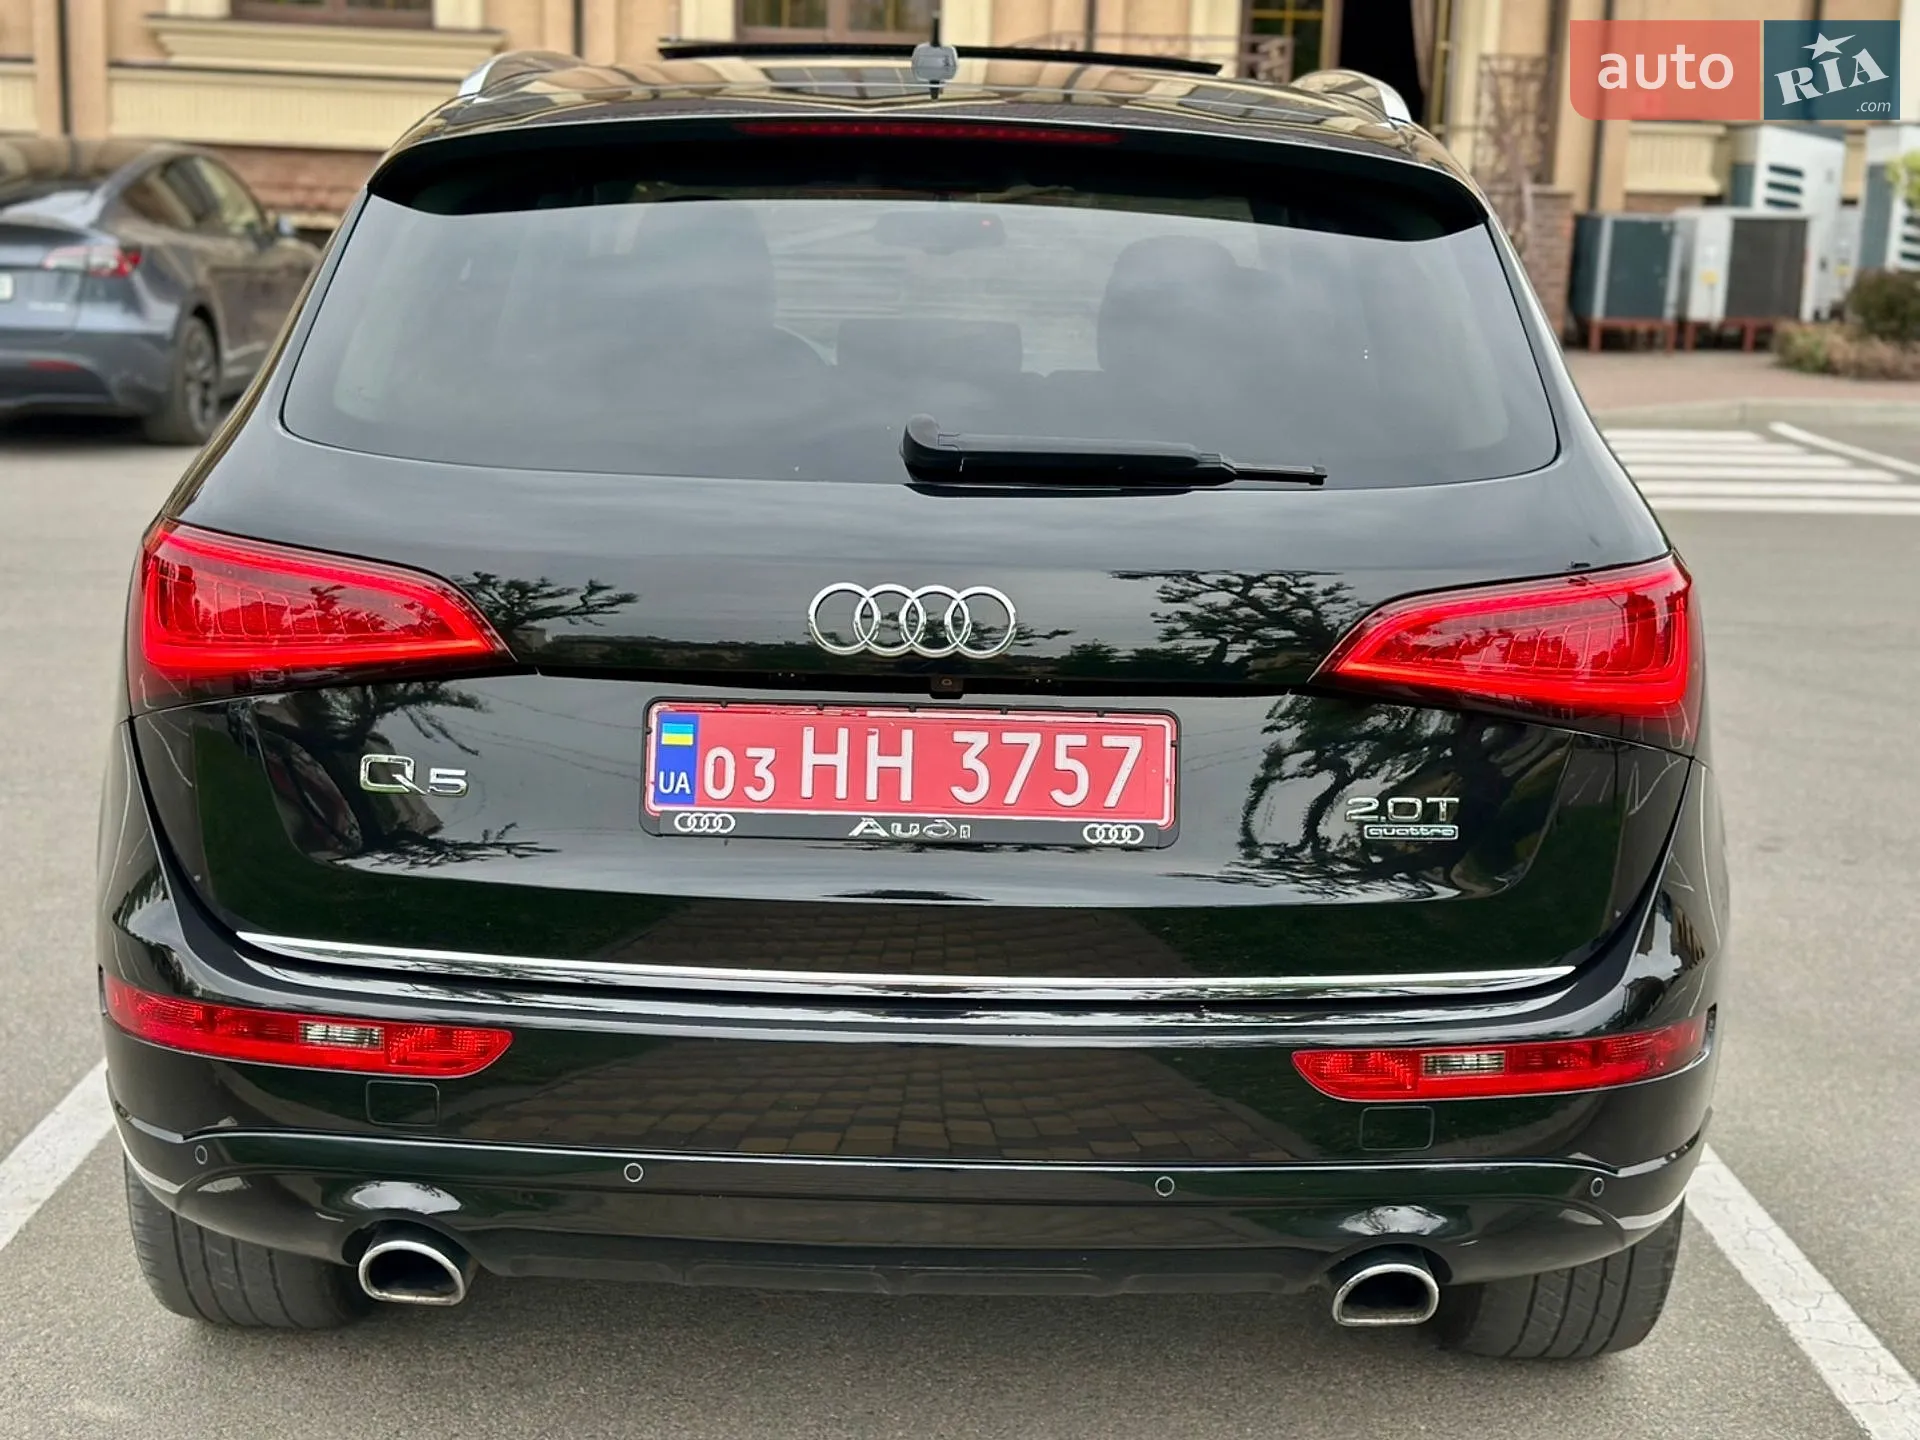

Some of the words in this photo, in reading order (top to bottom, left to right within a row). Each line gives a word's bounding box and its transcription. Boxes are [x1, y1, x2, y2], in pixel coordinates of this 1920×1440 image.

[359, 754, 469, 797] Q5
[703, 746, 776, 803] 03
[801, 726, 913, 802] HH
[950, 730, 1144, 808] 3757
[658, 769, 691, 796] UA
[1345, 796, 1460, 823] 2.0T
[1368, 827, 1456, 838] quattro
